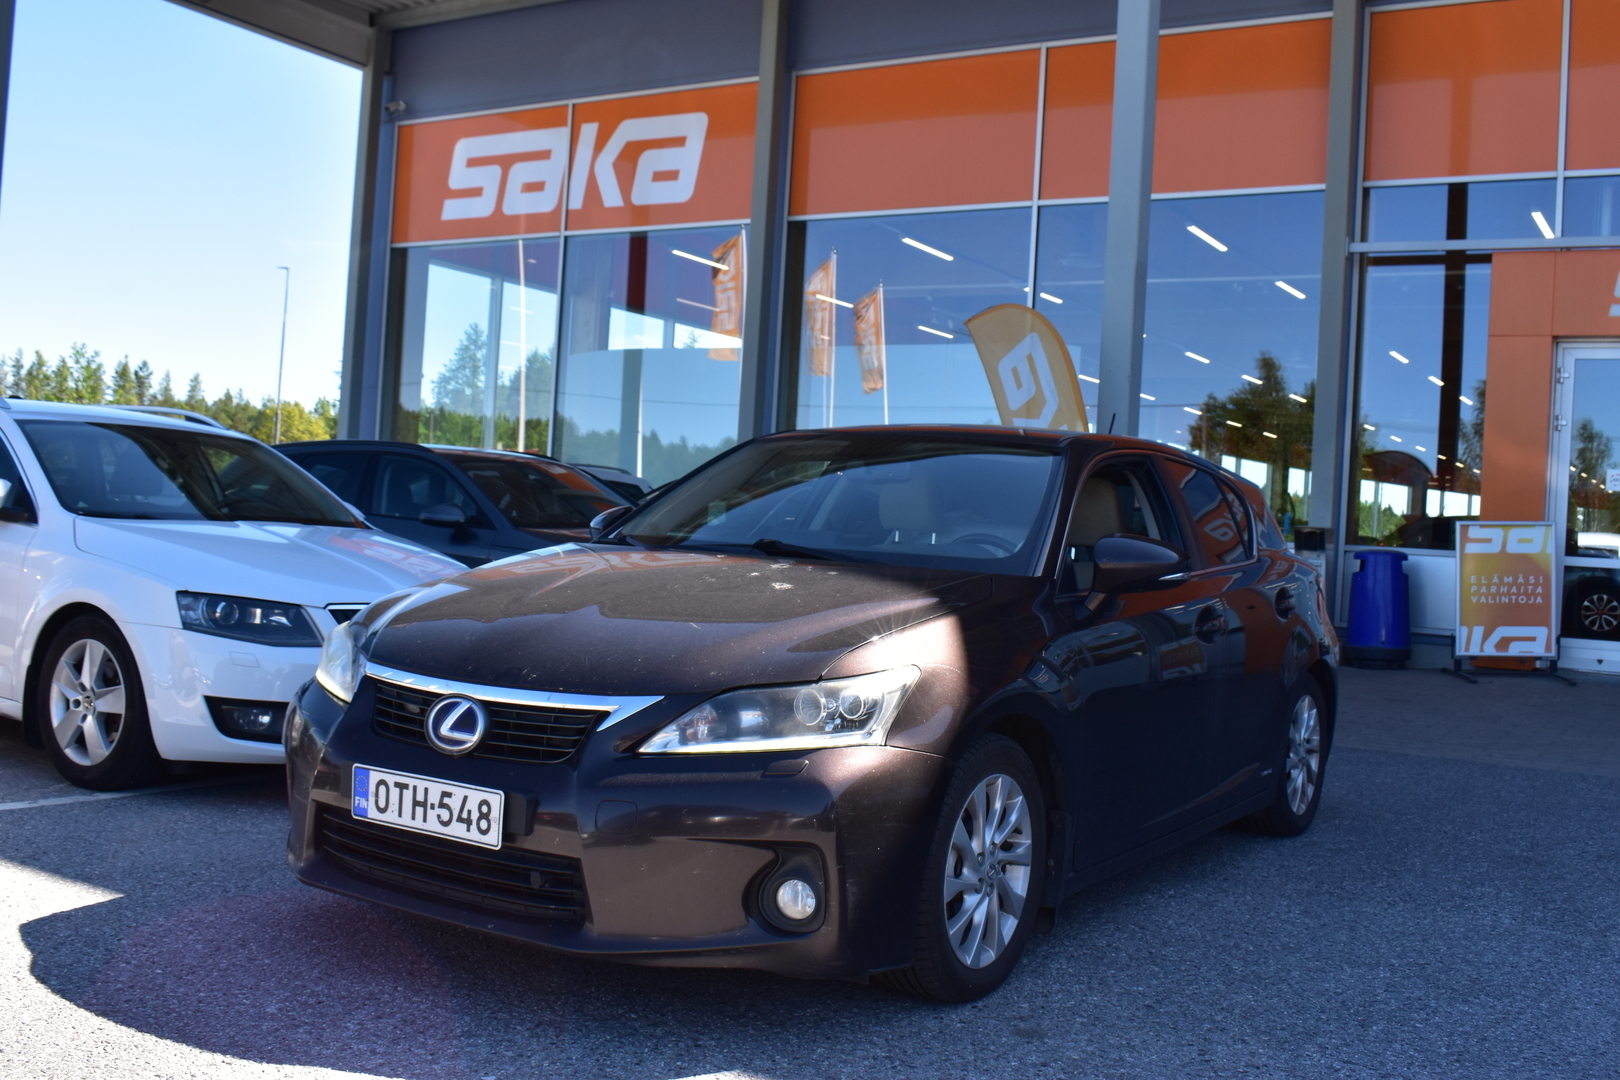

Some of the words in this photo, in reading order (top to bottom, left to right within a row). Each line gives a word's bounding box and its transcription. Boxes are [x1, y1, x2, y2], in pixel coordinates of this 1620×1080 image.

[1470, 573, 1543, 584] ELÄMÄSI
[1470, 585, 1543, 594] PARHAITA
[1470, 595, 1543, 604] VALINTOJA
[354, 796, 368, 809] FIN
[374, 778, 492, 836] OTH-548
